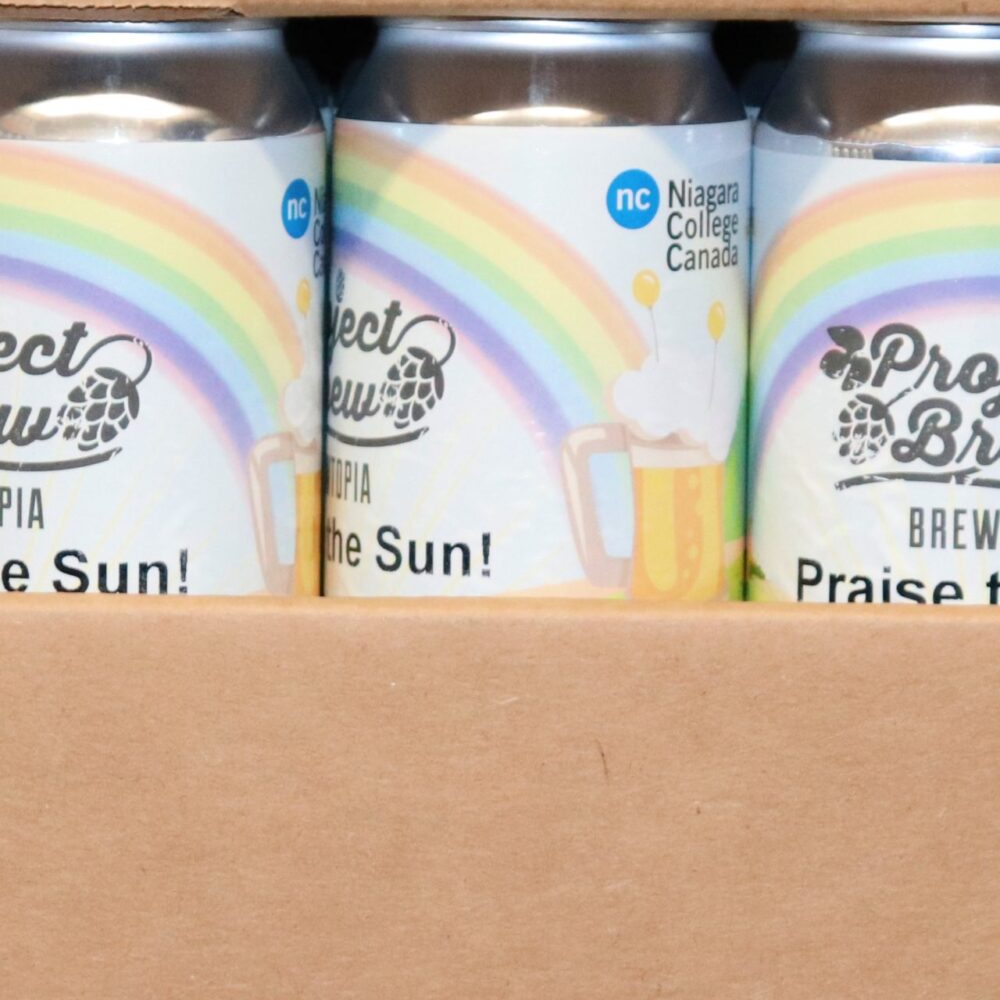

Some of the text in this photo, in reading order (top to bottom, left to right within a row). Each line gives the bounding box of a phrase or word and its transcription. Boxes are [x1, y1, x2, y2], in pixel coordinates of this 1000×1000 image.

[287, 197, 308, 221] nc
[616, 187, 652, 212] nc
[667, 178, 740, 213] Niagara
[666, 208, 740, 243] College
[665, 241, 740, 272] Canada
[375, 524, 491, 578] Sun!
[52, 548, 188, 596] Sun!
[797, 556, 965, 604] Praise
